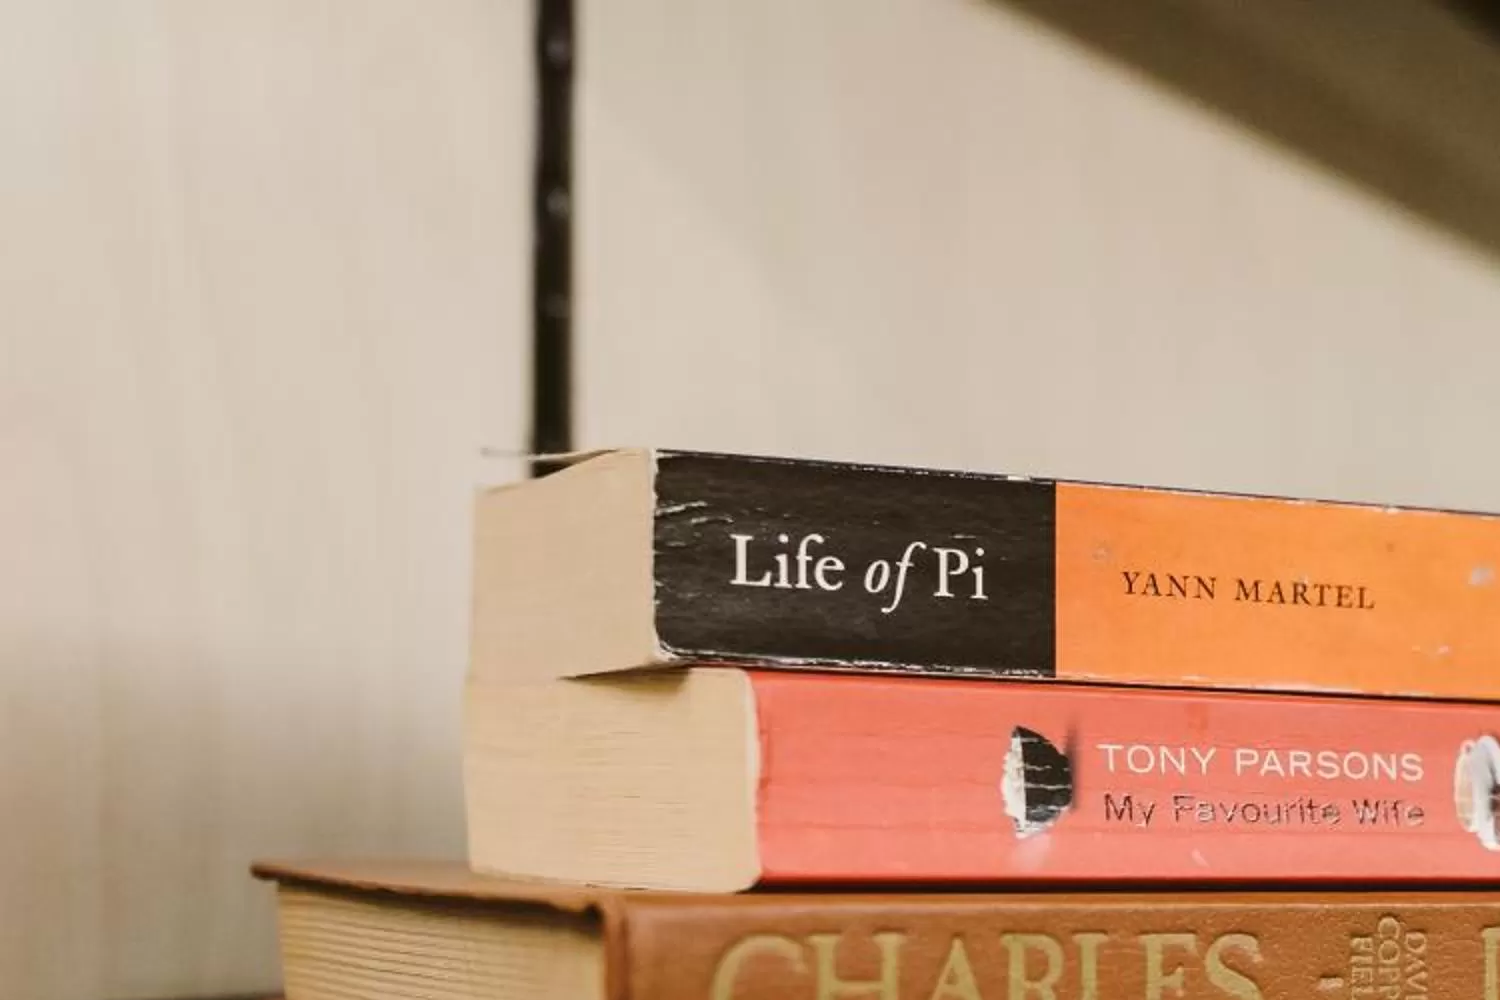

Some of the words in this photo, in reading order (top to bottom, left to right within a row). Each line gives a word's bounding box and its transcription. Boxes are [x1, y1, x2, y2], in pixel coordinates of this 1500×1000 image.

[730, 532, 846, 592] Life
[863, 541, 926, 614] of
[932, 546, 989, 600] Pi
[1121, 570, 1217, 600] YANN
[1234, 577, 1376, 610] MARTEL
[1096, 743, 1217, 776] TONY
[1235, 748, 1425, 782] PARSONS
[1104, 793, 1155, 827] My
[1173, 795, 1342, 827] Favourite
[1353, 799, 1426, 828] Wife
